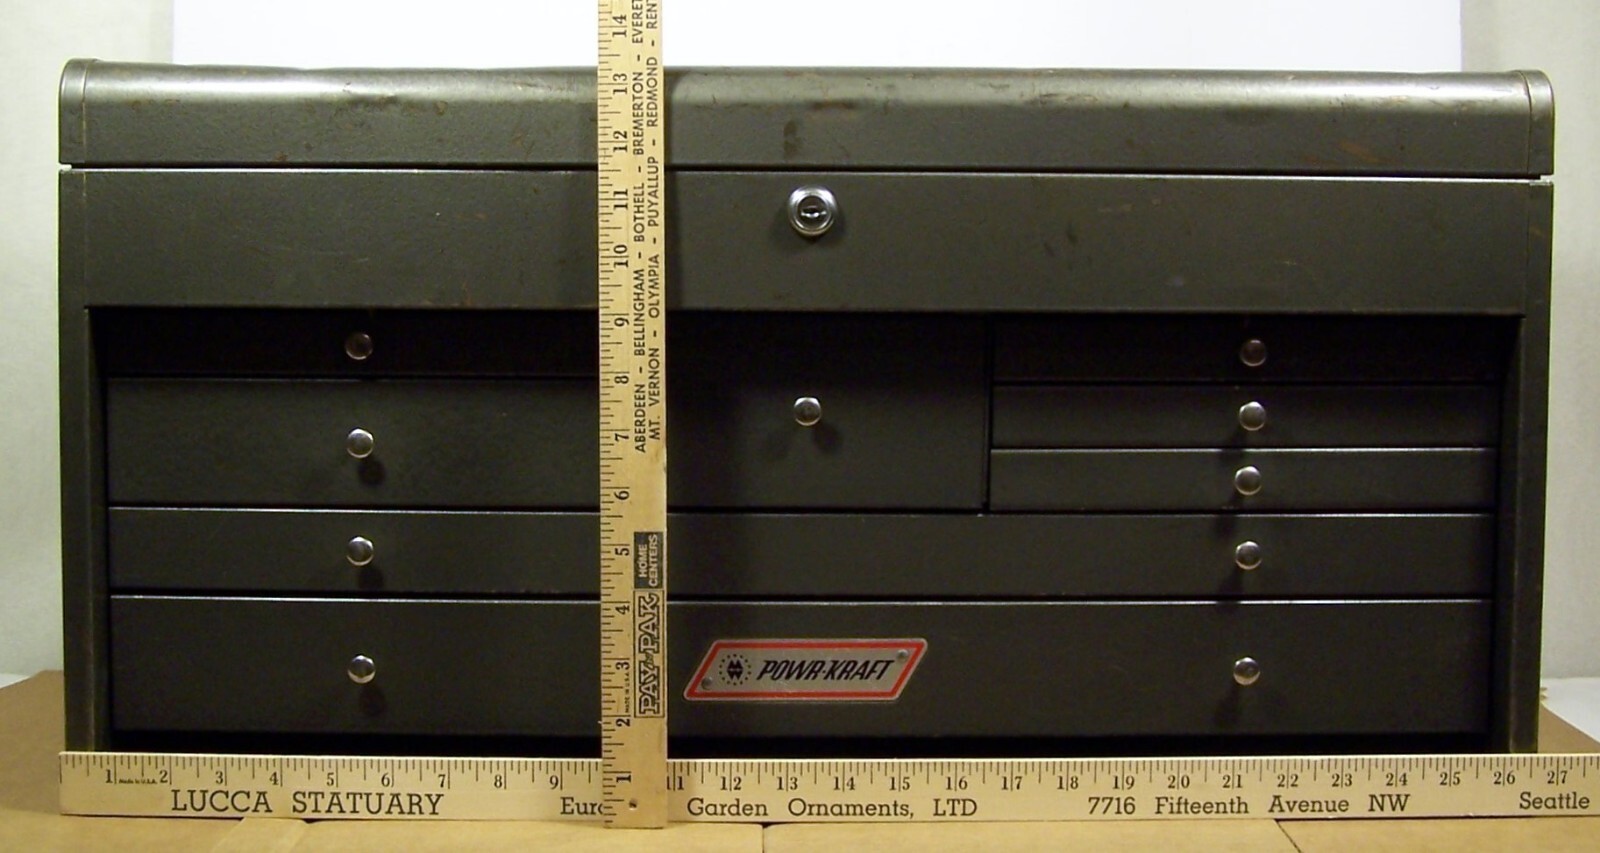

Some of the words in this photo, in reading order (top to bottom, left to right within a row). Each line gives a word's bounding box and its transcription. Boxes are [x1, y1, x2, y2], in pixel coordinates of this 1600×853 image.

[612, 14, 627, 37] 14
[646, 0, 658, 29] REN
[612, 73, 627, 94] 13
[646, 56, 658, 127] REDMOND
[632, 72, 644, 155] BREMERTON
[613, 130, 628, 152] 12
[613, 189, 628, 210] 11
[647, 156, 659, 227] PUYALLUP
[633, 183, 645, 242] BOTHELL
[613, 244, 629, 268] 10
[648, 254, 660, 318] OLYMPIA
[614, 317, 629, 327] 9
[633, 269, 645, 356] BELLINGHAM
[614, 375, 629, 384] 8
[648, 348, 660, 407] VERNON
[634, 384, 646, 453] ABERDEEN
[648, 416, 660, 440] MT.
[614, 433, 629, 442] 7
[614, 490, 629, 500] 6
[615, 548, 630, 556] 5
[638, 544, 647, 578] HOME
[648, 534, 658, 587] CENTERS
[615, 605, 630, 615] 4
[638, 593, 660, 654] PAK
[615, 662, 630, 670] 3
[639, 660, 660, 714] PAY
[616, 718, 630, 727] 2
[105, 769, 113, 783] 1
[159, 770, 168, 784] 2
[215, 771, 224, 785] 3
[269, 771, 279, 786] 4
[326, 772, 335, 787] 5
[381, 773, 391, 787] 6
[438, 774, 446, 788] 7
[494, 774, 503, 789] 8
[550, 775, 559, 790] 9
[720, 776, 742, 790] 12
[777, 776, 798, 790] 13
[833, 776, 855, 790] 14
[889, 776, 910, 790] 15
[945, 776, 968, 790] 16
[1001, 776, 1023, 790] 17
[1057, 775, 1079, 790] 18
[1112, 775, 1135, 790] 19
[1168, 775, 1190, 789] 20
[1222, 775, 1243, 789] 21
[1277, 774, 1299, 788] 22
[1331, 773, 1353, 787] 23
[1386, 773, 1408, 786] 24
[1439, 772, 1460, 786] 25
[1493, 771, 1516, 785] 26
[1547, 771, 1568, 784] 27
[616, 775, 631, 783] 1
[171, 789, 272, 813] LUCCA
[292, 790, 444, 815] STATUARY
[687, 797, 769, 817] Garden
[788, 798, 914, 819] Ornaments,
[933, 798, 977, 817] LTD
[1088, 796, 1136, 815] 7716
[1154, 796, 1249, 815] Fifteenth
[1268, 794, 1350, 813] Avenue
[1368, 794, 1410, 812] NW
[1519, 792, 1590, 810] Seattle
